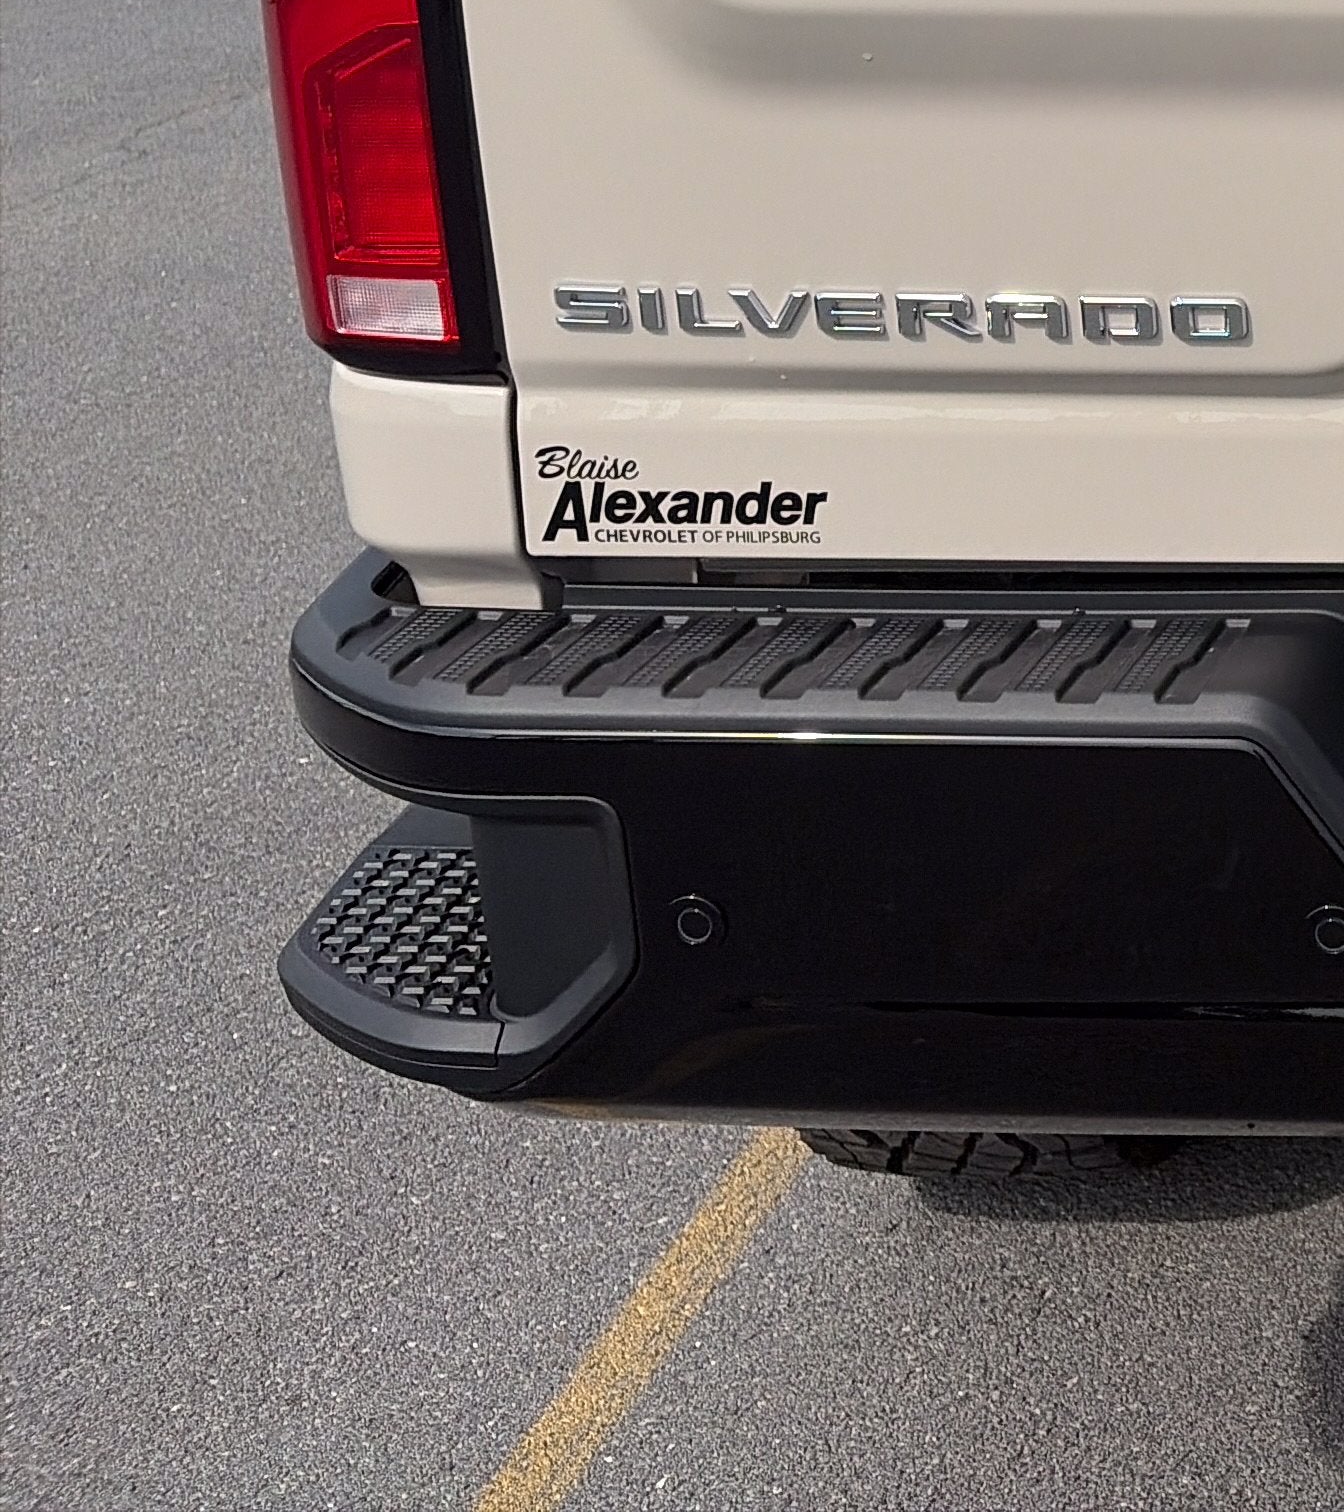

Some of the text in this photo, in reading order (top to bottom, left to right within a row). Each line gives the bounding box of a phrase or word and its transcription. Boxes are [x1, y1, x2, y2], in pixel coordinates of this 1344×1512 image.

[553, 286, 1252, 344] SILVERADO
[535, 445, 639, 480] Blaise
[541, 480, 828, 542] Alexander
[594, 528, 822, 544] CHEVROLET OF PHILIPSBURG
